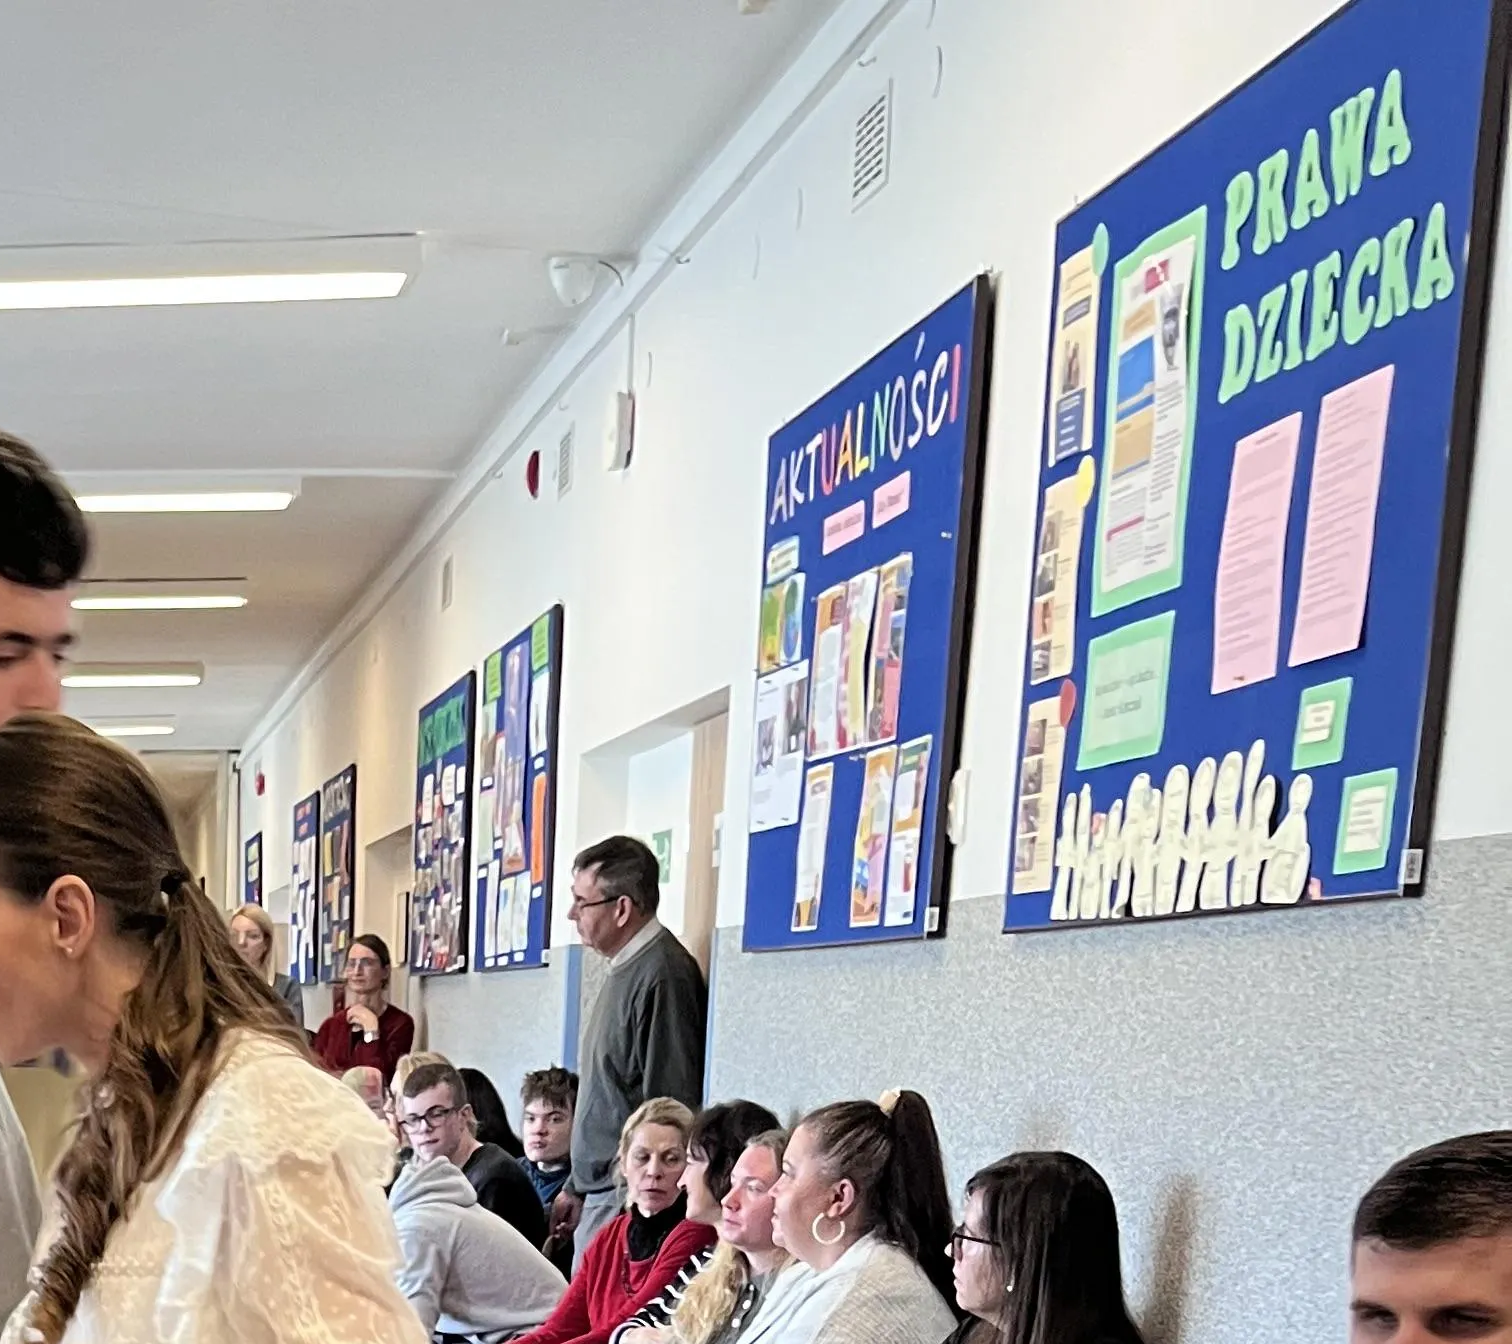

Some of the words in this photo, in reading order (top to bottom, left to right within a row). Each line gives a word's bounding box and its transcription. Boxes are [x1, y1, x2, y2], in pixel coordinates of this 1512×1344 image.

[1220, 68, 1412, 271] PRAWA
[1218, 202, 1454, 404] DZIECKA
[769, 331, 962, 525] AKTUALNOŚCI
